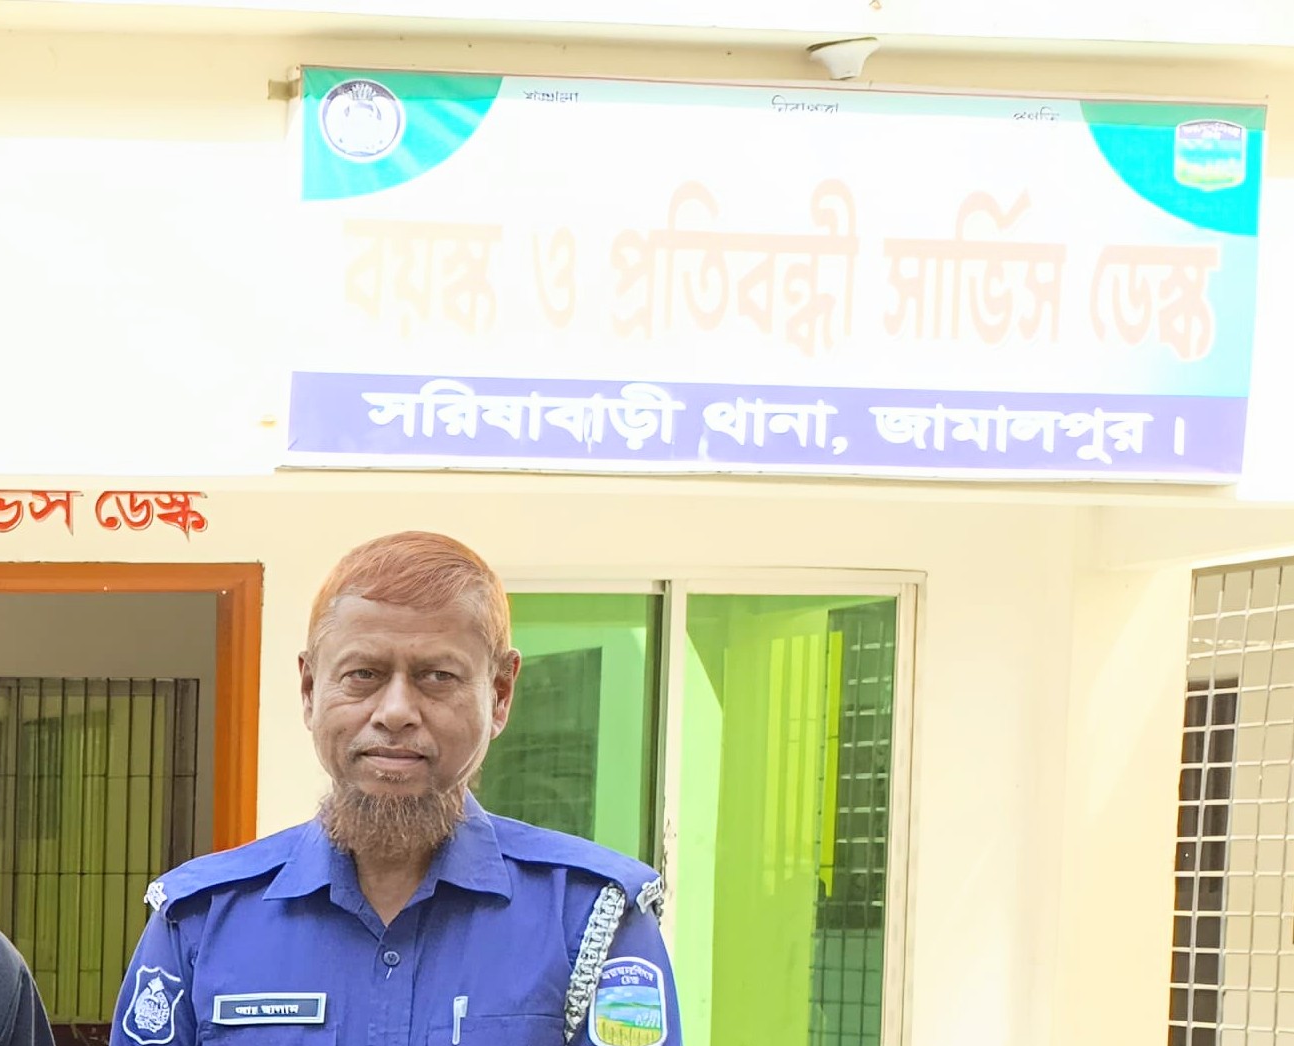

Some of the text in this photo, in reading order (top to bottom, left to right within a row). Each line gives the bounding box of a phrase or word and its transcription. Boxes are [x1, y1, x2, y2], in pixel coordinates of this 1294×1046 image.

[531, 226, 578, 331] ও
[610, 178, 859, 358] প্রতিবন্ধী
[883, 188, 1067, 345] সার্ভিস
[1090, 243, 1221, 362] ডেস্ক
[361, 379, 686, 450] সরিষাবাড়ী
[702, 397, 848, 456] থানা,
[868, 402, 1154, 465] জামালপুর
[94, 490, 208, 543] ডেস্ক
